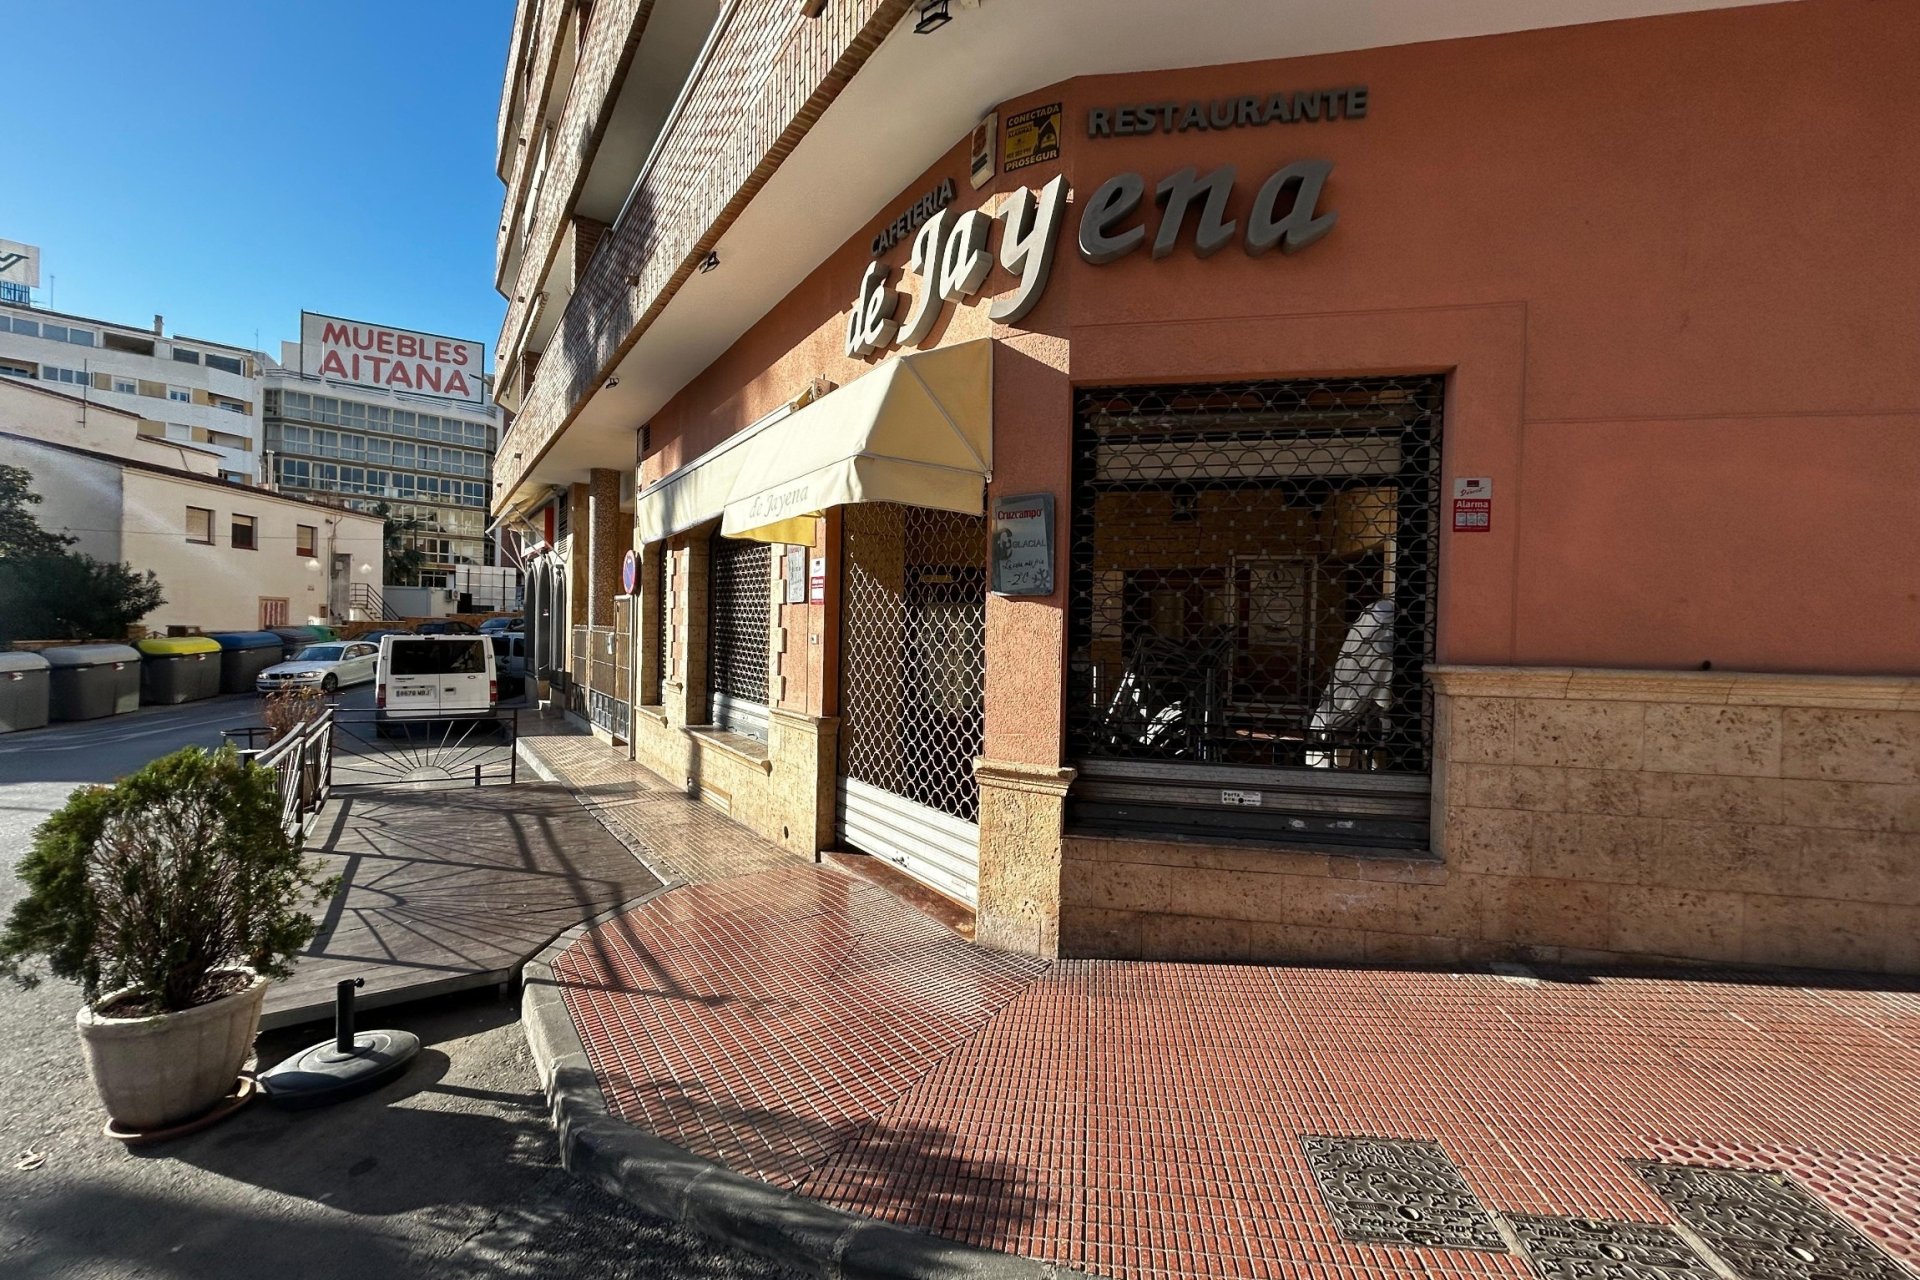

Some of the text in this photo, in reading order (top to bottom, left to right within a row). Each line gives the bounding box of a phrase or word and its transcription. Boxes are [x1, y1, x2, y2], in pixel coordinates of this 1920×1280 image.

[1008, 104, 1060, 127] CONECTADA
[1088, 86, 1368, 138] RESTAURANTE
[1006, 150, 1057, 171] PROSEGUR
[870, 177, 957, 257] CAFETERIA
[846, 160, 1339, 360] de Jayena
[322, 322, 468, 366] MUEBLES
[318, 350, 470, 397] AITANA
[763, 485, 809, 518] Jayena
[997, 508, 1043, 520] Cruzcampo
[1456, 500, 1489, 508] Alarma
[1013, 539, 1047, 549] GLACIAL
